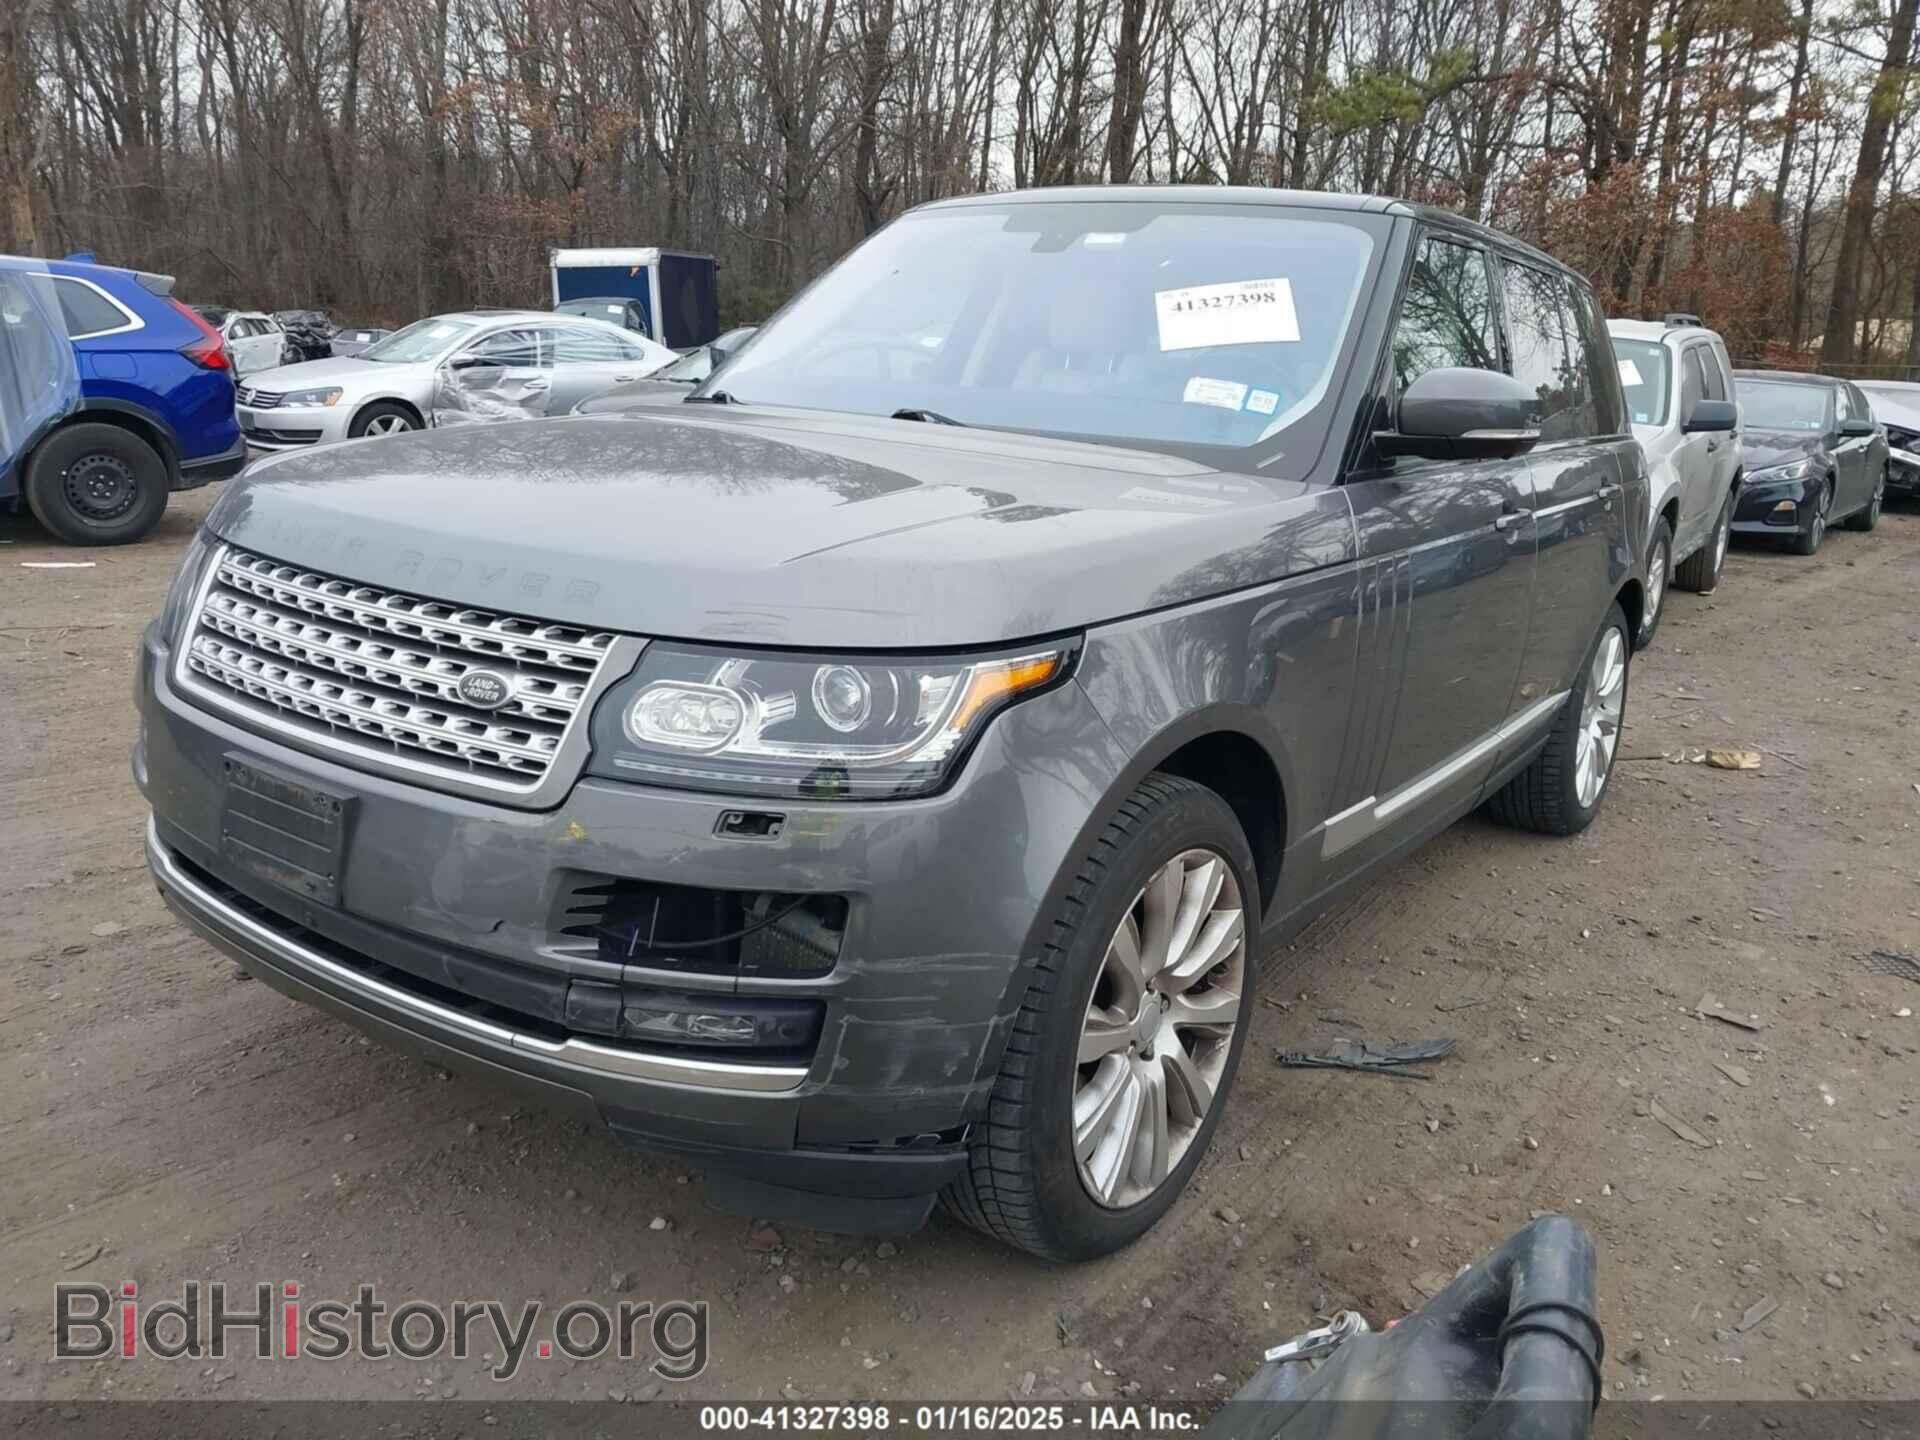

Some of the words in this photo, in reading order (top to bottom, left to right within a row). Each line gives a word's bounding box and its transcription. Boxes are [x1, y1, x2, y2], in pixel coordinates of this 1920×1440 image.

[1170, 291, 1276, 312] 41327398
[468, 677, 494, 690] LAND
[467, 687, 499, 701] ROVER
